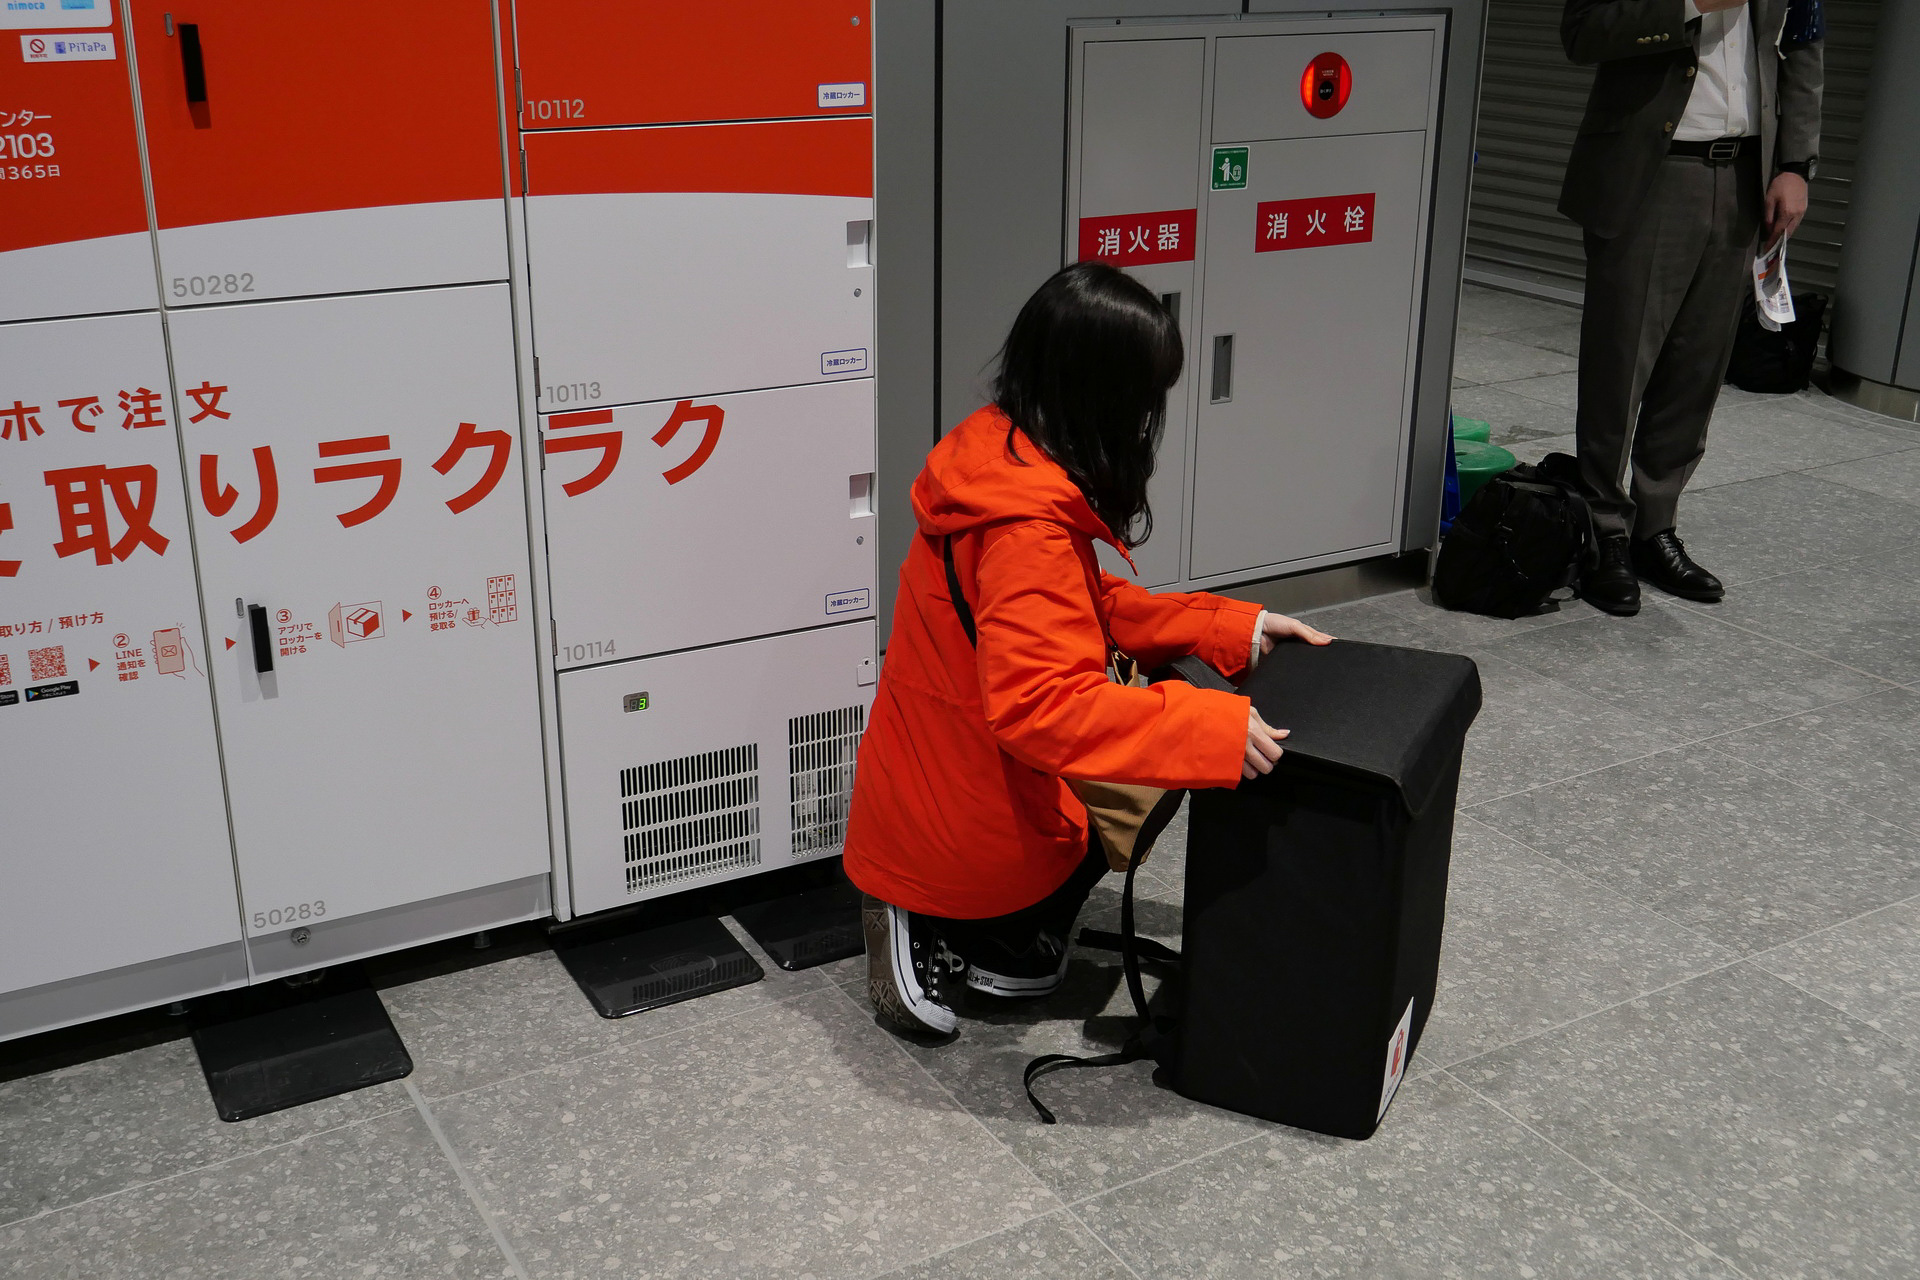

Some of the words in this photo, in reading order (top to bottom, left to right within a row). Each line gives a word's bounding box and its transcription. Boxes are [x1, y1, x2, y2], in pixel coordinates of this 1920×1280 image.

[7, 1, 46, 10] nimoca
[69, 42, 107, 53] PiTaPa
[823, 91, 860, 100] 冷蔵ロッカー
[527, 98, 585, 120] 10112
[0, 109, 52, 127] ンター
[1266, 205, 1366, 241] 消火栓
[1096, 222, 1181, 257] 消火器
[172, 273, 255, 298] 50282
[826, 356, 862, 367] 冷蔵ロッカー
[546, 382, 602, 404] 10113
[0, 400, 725, 577] 取りラクラク
[429, 598, 469, 610] ロッカーへ
[830, 596, 865, 607] 冷蔵ロッカー
[58, 611, 104, 629] 預け方
[430, 620, 456, 632] 受取る
[278, 622, 313, 635] アプリで
[279, 632, 322, 646] ロッカーを
[115, 648, 142, 659] LINE
[280, 645, 307, 657] 開ける
[563, 639, 616, 664] 10114
[117, 659, 146, 671] 通知を
[118, 671, 139, 682] 確認
[40, 686, 60, 694] Google
[638, 698, 647, 710] 3
[253, 899, 327, 929] 50283
[979, 976, 993, 987] STAR
